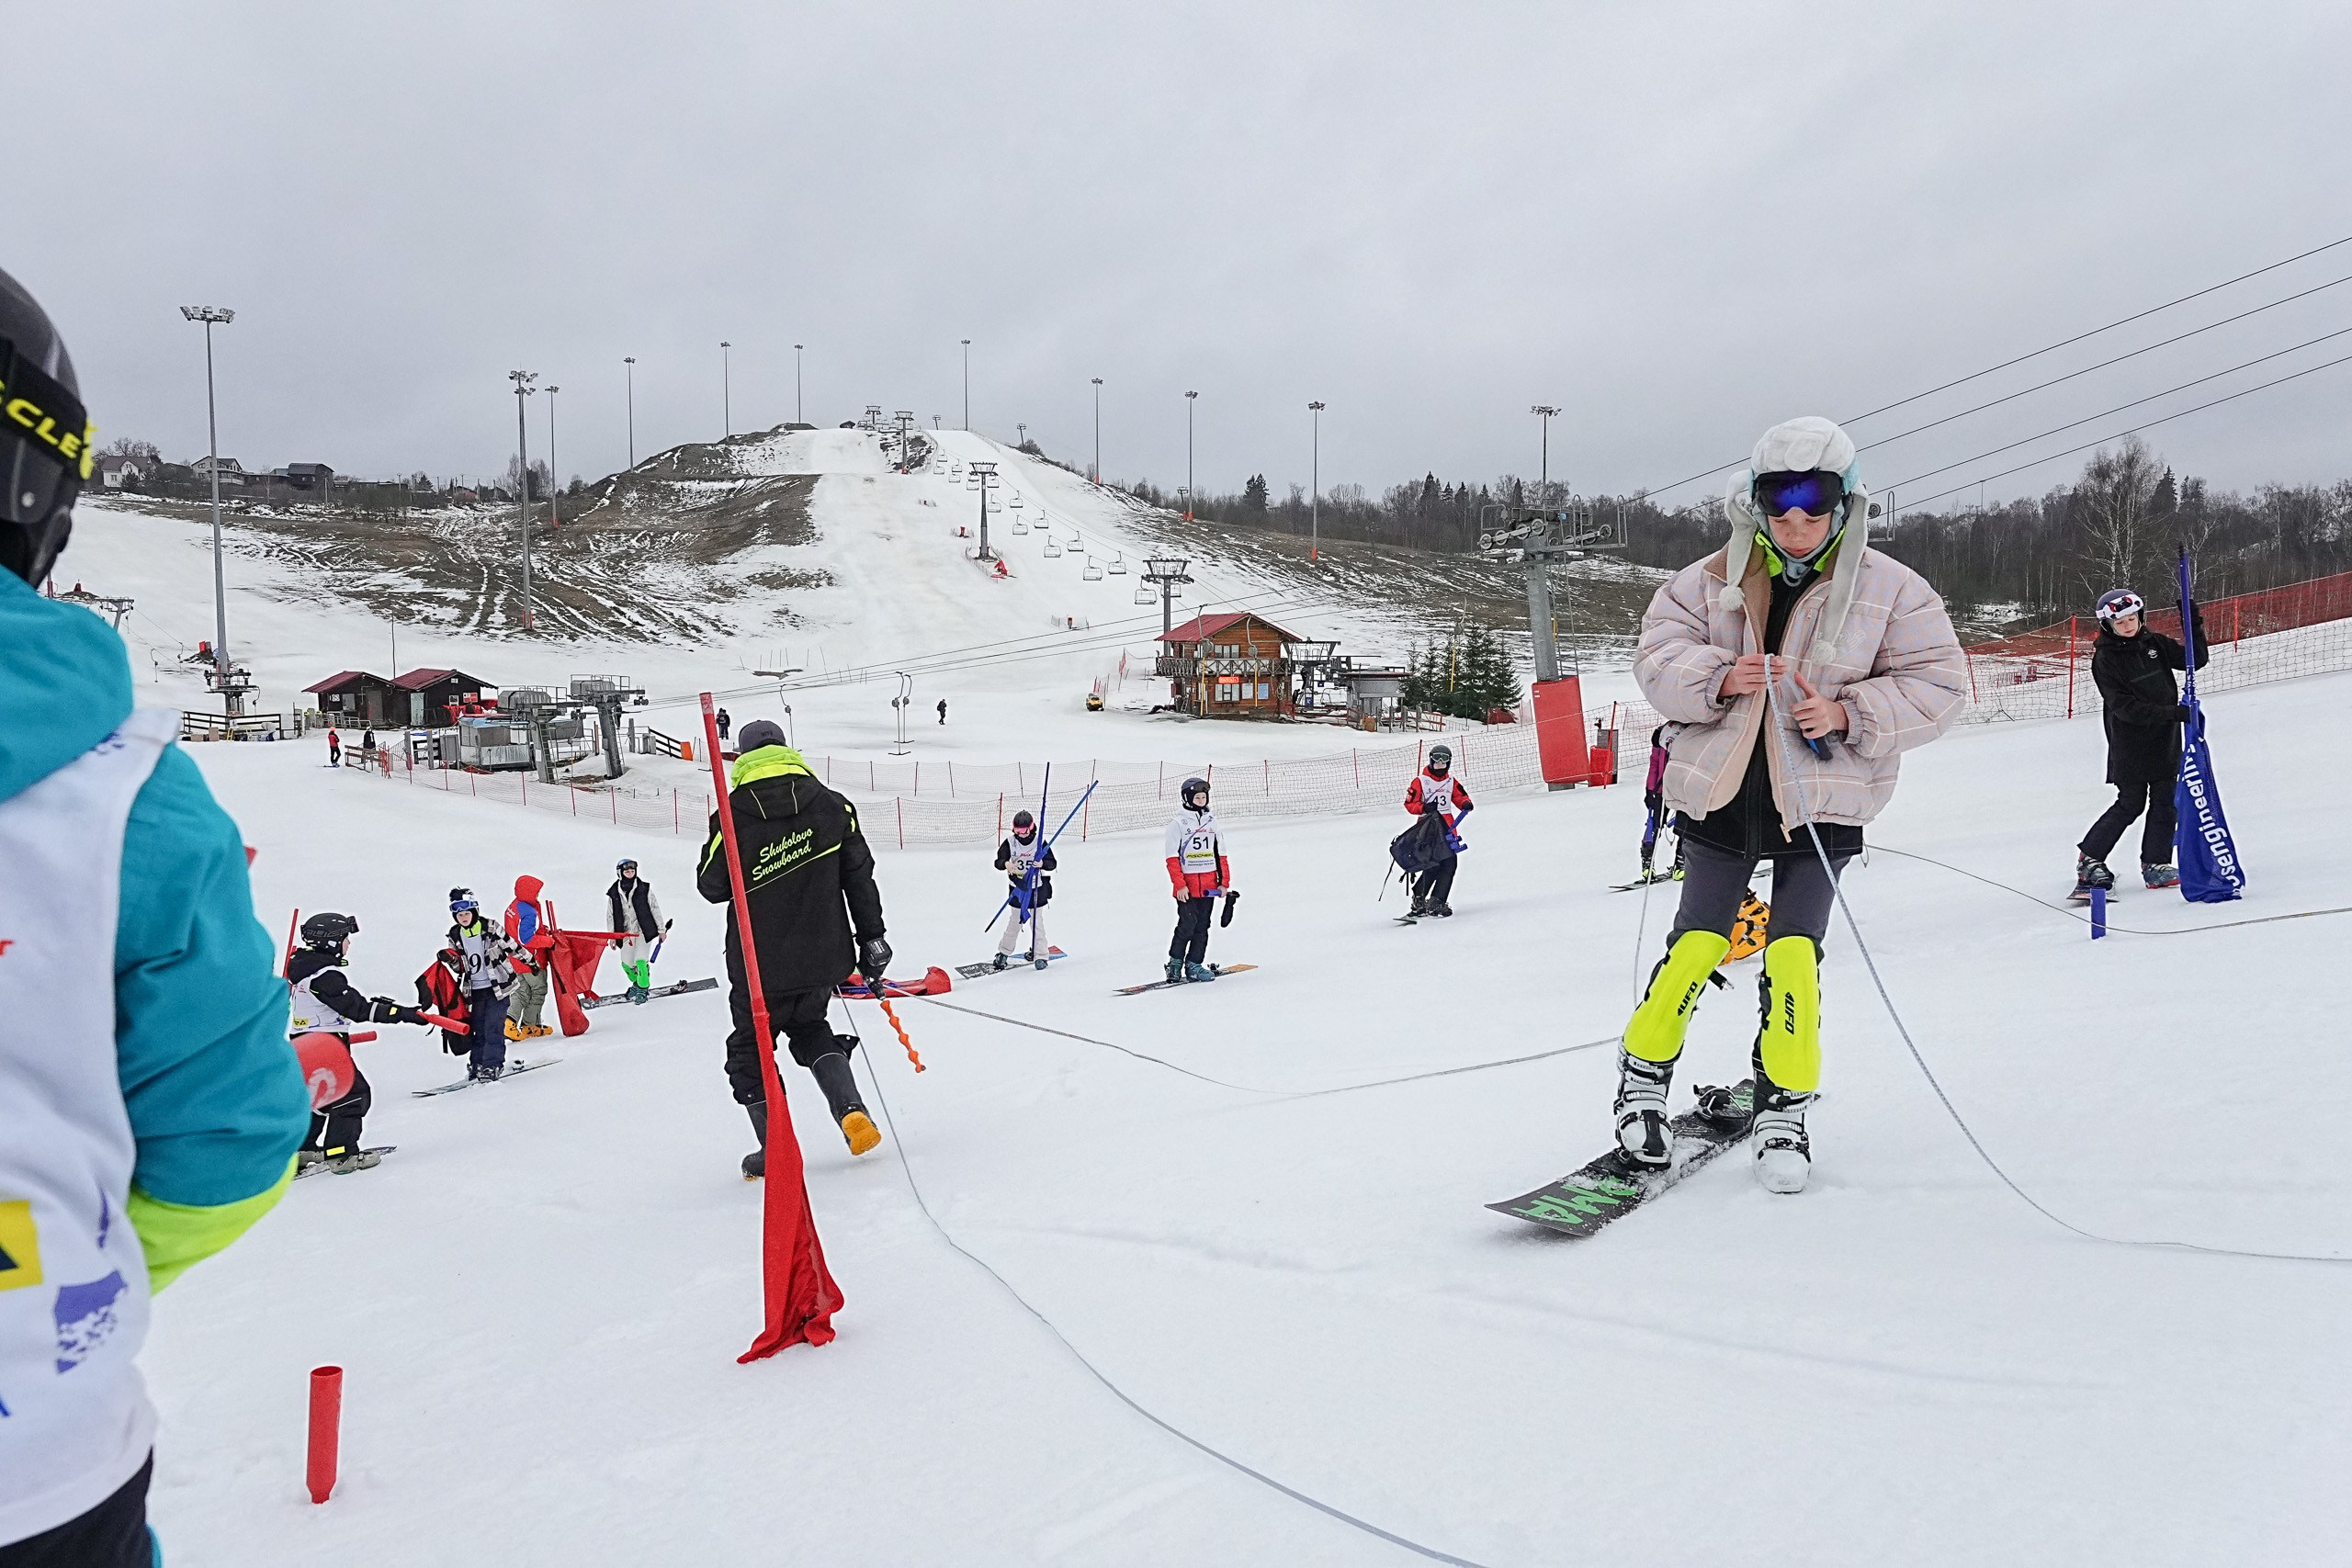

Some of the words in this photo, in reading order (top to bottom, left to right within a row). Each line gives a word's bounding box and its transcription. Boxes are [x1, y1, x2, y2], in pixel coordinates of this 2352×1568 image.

[1431, 795, 1447, 807] 43
[760, 829, 813, 863] Shukolovo
[1193, 836, 1209, 851] 51
[752, 840, 812, 881] Snowboard
[469, 953, 482, 976] 9
